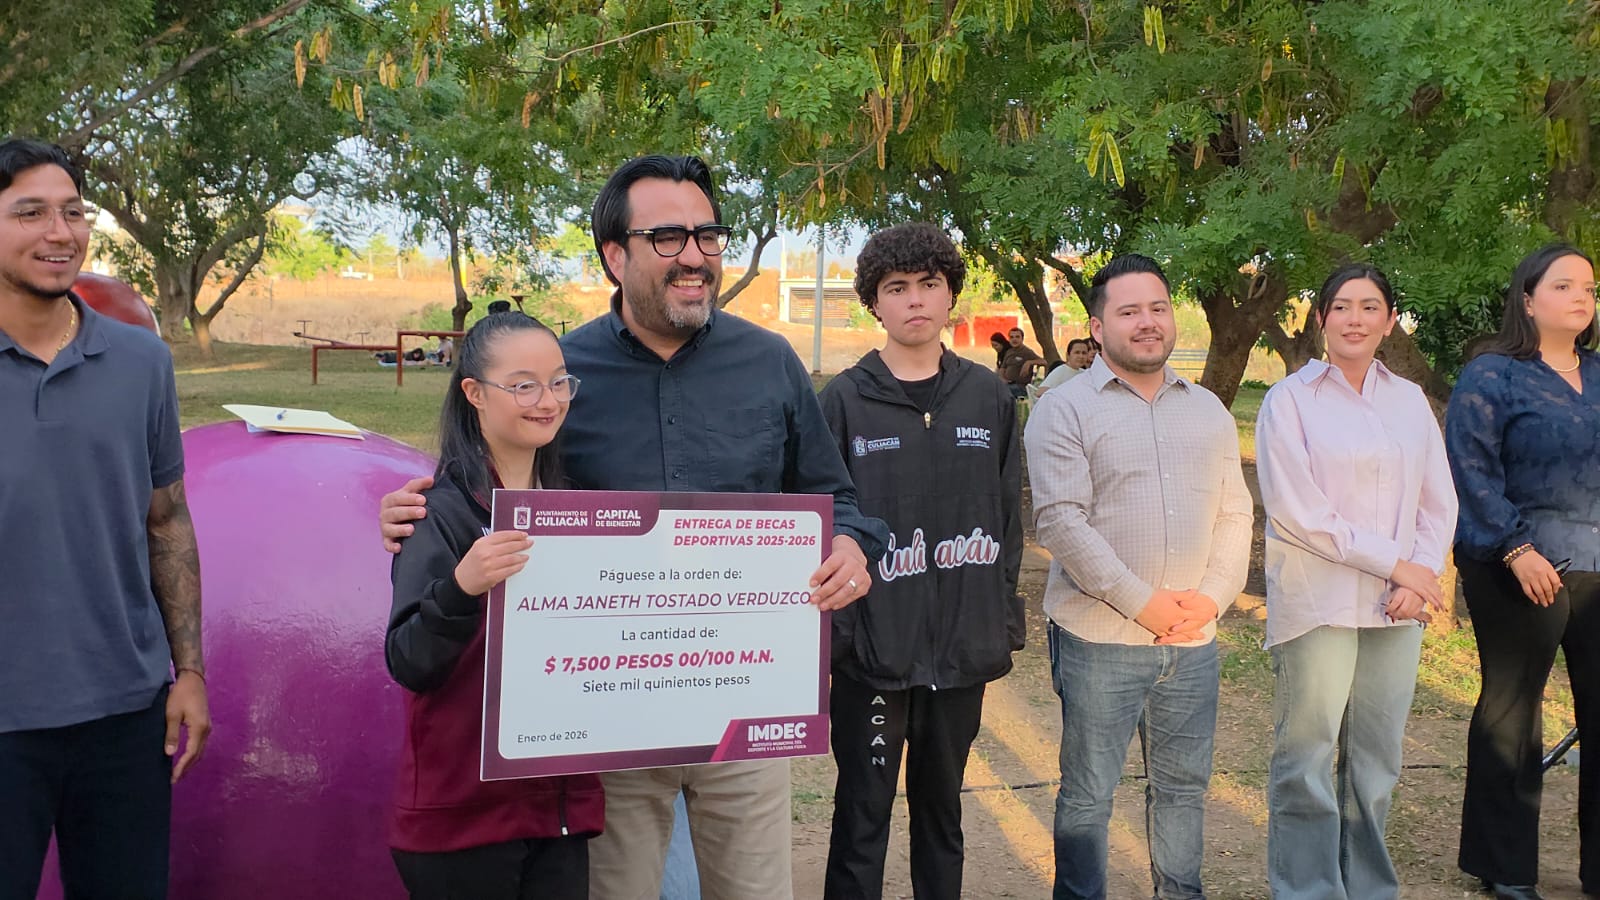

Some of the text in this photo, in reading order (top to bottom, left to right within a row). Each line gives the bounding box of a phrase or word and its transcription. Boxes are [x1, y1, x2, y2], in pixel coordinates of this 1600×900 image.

[956, 427, 991, 441] IMDEC
[535, 515, 588, 527] CULIACÁN
[596, 509, 641, 520] CAPITAL
[674, 518, 796, 530] ENTREGA DE BECAS
[673, 535, 816, 546] DEPORTIVAS 2025-2026
[600, 568, 742, 584] Páguese a la orden de:
[517, 591, 811, 611] ALMA JANETH TOSTADO VERDUZCO
[621, 627, 719, 641] La cantidad de:
[544, 649, 774, 675] $ 7,500 PESOS 00/100 M.N.
[583, 675, 750, 693] Siete mil quinientos pesos
[517, 730, 588, 743] Enero de 2026
[747, 722, 807, 742] IMDEC
